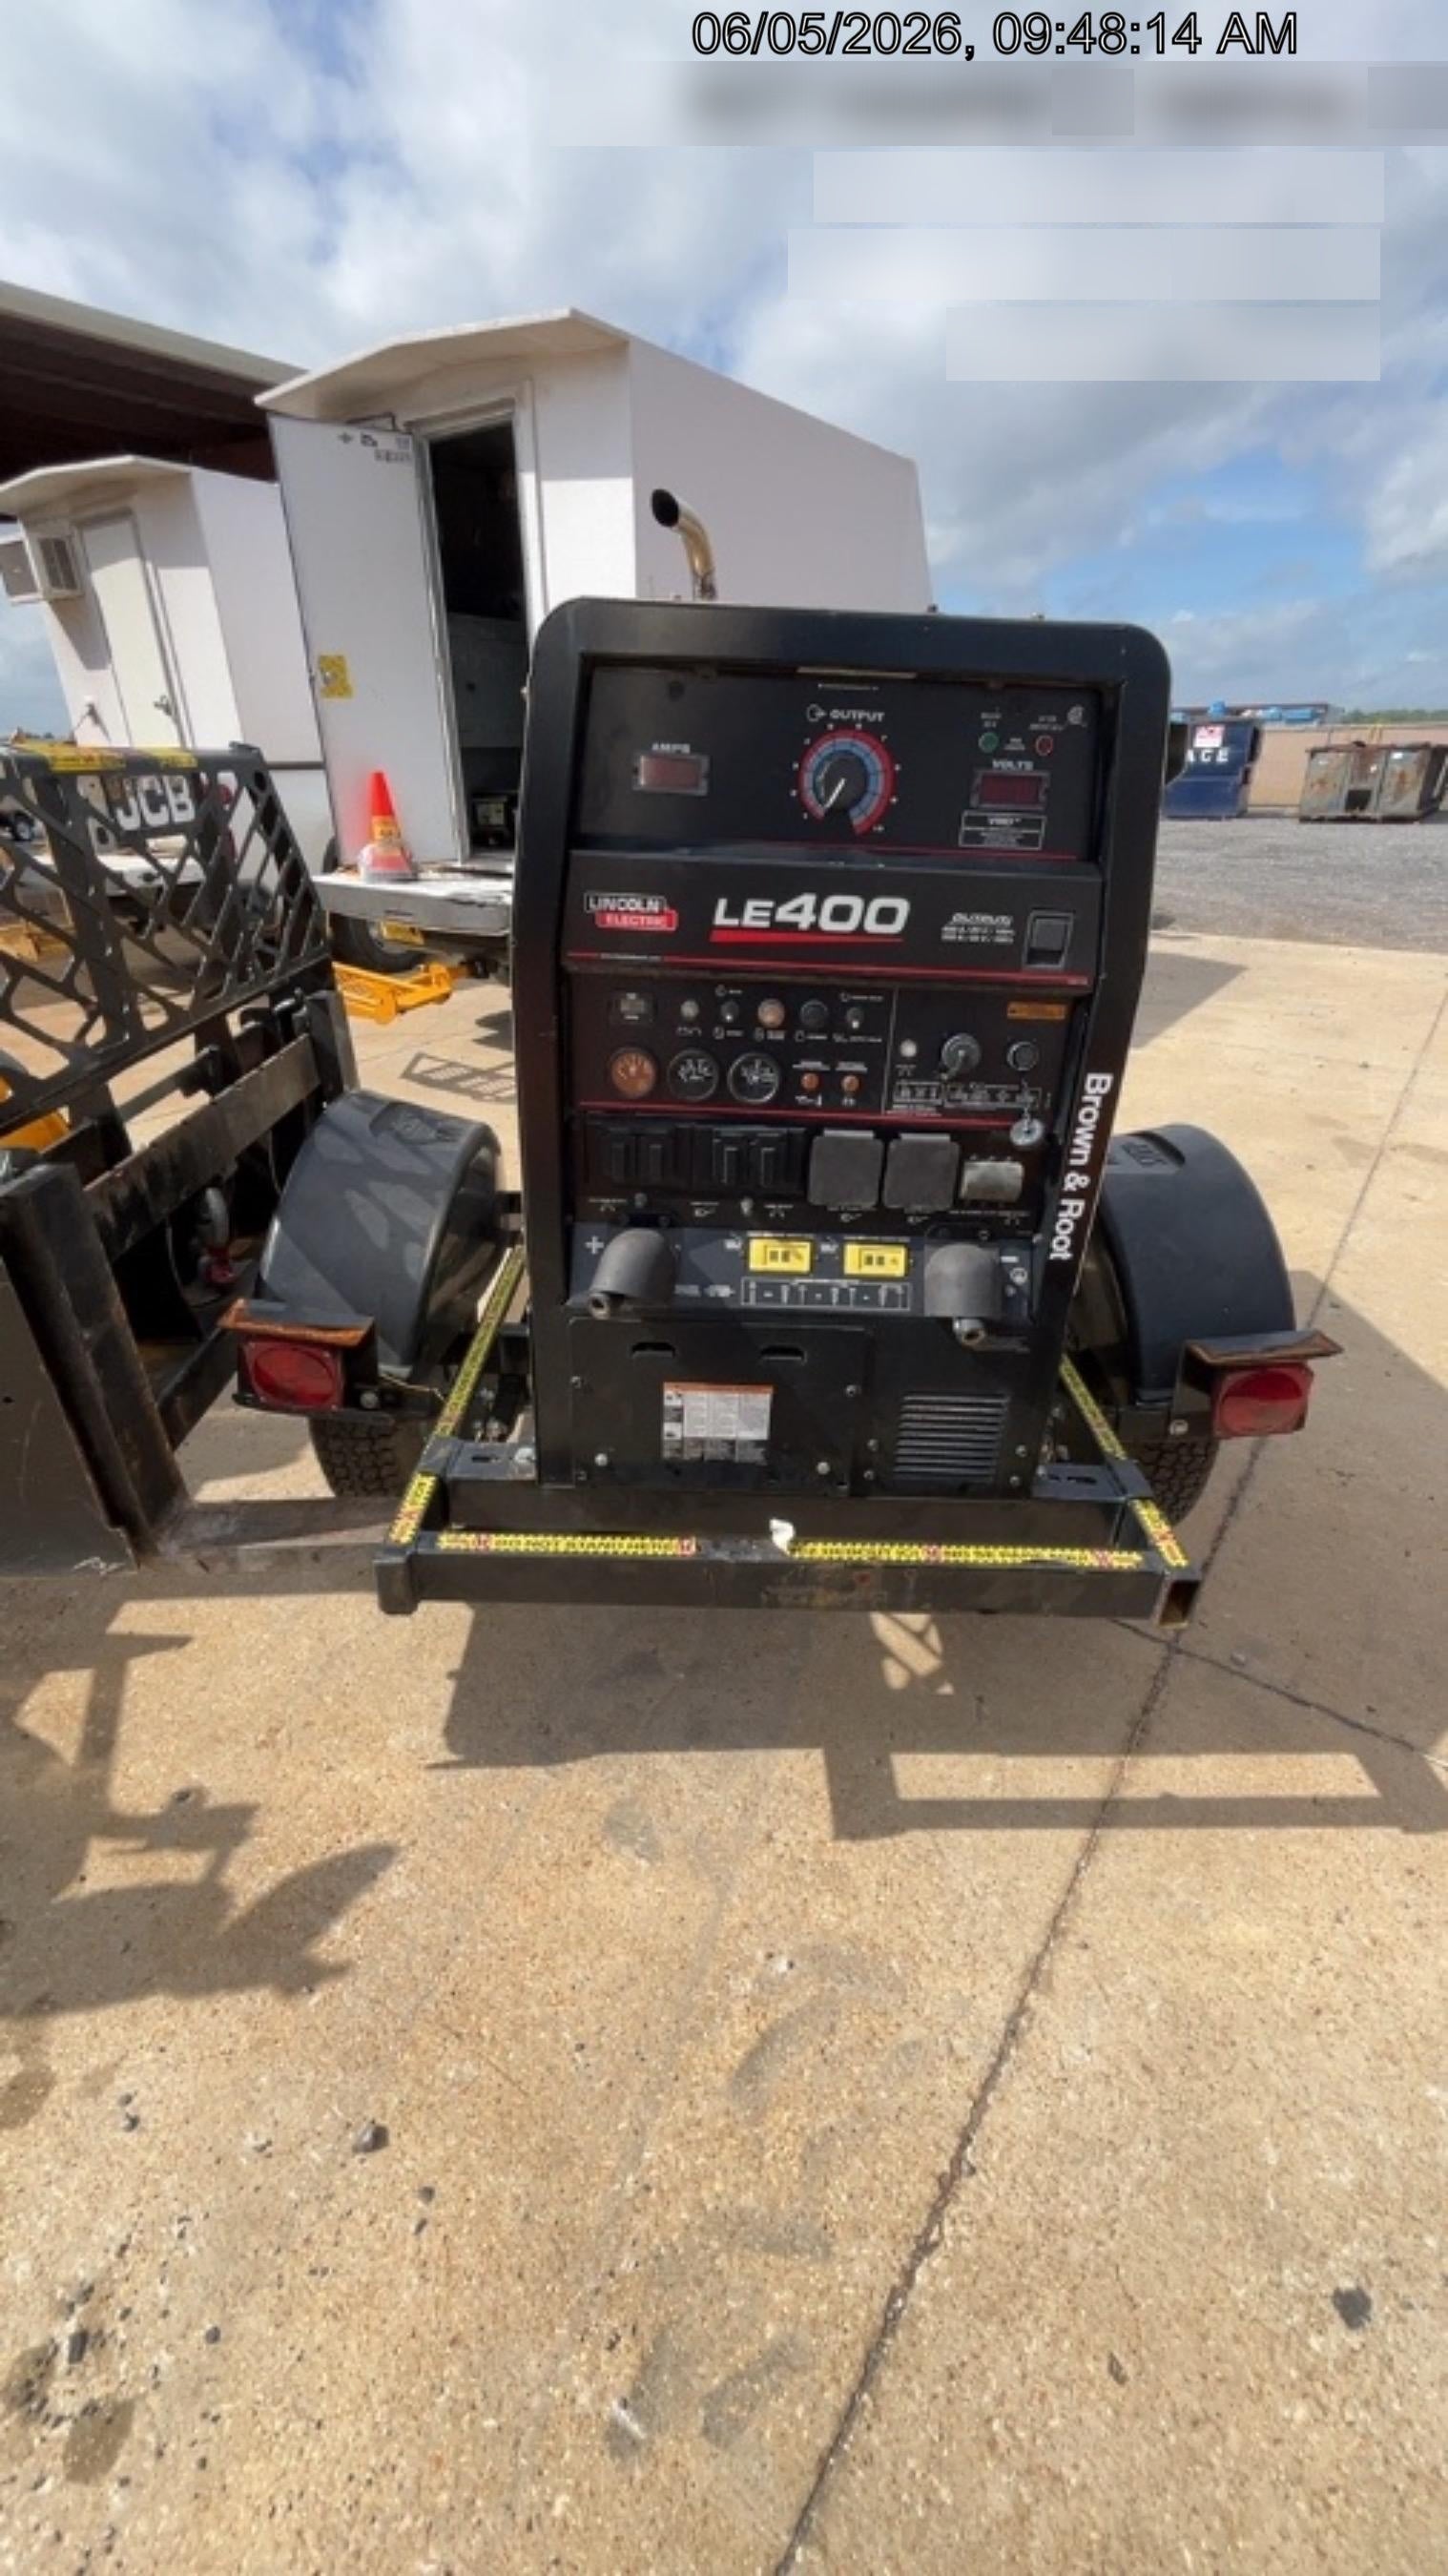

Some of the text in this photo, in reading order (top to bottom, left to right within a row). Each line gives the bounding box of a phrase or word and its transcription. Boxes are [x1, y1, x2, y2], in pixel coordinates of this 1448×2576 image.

[830, 709, 884, 722] OUTPUT
[116, 775, 195, 830] JCB
[590, 897, 660, 913] LINCOLN
[713, 892, 910, 934] LE400
[605, 913, 668, 927] ELECTRIC
[1048, 1072, 1114, 1260] Brown & Root
